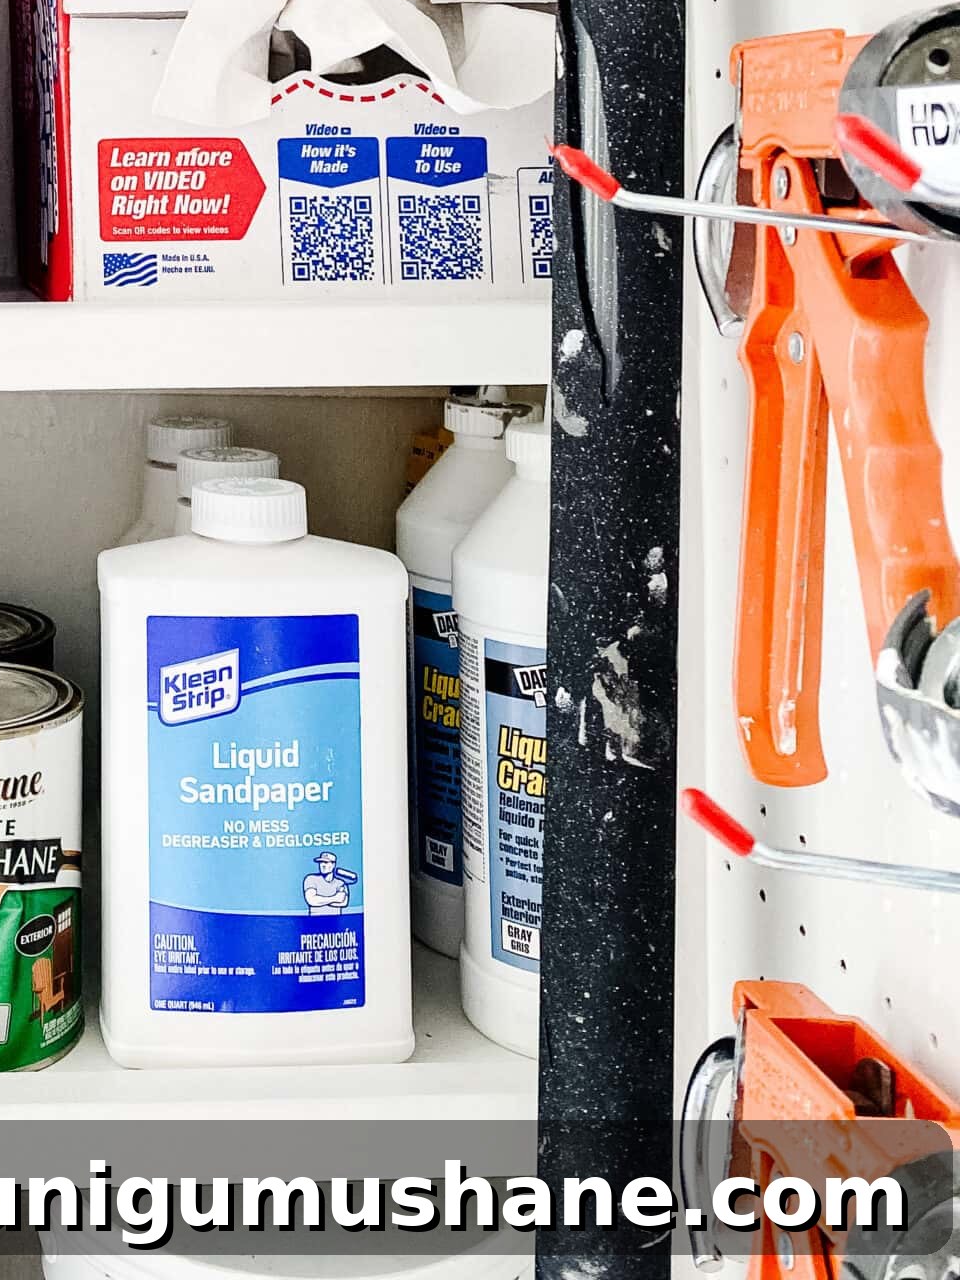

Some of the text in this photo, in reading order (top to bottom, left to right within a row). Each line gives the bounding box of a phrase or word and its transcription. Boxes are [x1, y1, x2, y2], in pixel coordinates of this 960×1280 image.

[305, 124, 338, 136] Video
[414, 124, 446, 136] Video
[110, 147, 233, 168] Learn more
[301, 144, 356, 158] How it's
[420, 144, 454, 157] How
[310, 160, 348, 174] Made
[414, 160, 461, 173] To Use
[110, 170, 206, 191] on VIDEO
[111, 194, 231, 220] Right Now!
[148, 226, 170, 234] codes
[173, 226, 180, 234] to
[182, 226, 201, 234] view
[203, 226, 229, 234] videos
[164, 666, 233, 694] Klean
[172, 686, 225, 712] Strip
[499, 725, 547, 767] Liqu
[213, 739, 300, 776] Liquid
[180, 775, 333, 811] Sandpaper
[224, 820, 289, 832] NO MESS
[162, 832, 350, 848] DEGREASER & DEGLOSSER
[515, 832, 539, 848] quick
[20, 925, 53, 946] EXTERIOR
[301, 928, 358, 950] PRECAUCIÓN.
[508, 925, 532, 943] GRAY
[154, 934, 196, 951] CAUTION.
[511, 939, 530, 954] GRIS
[314, 951, 323, 962] DE
[325, 950, 337, 962] LOS
